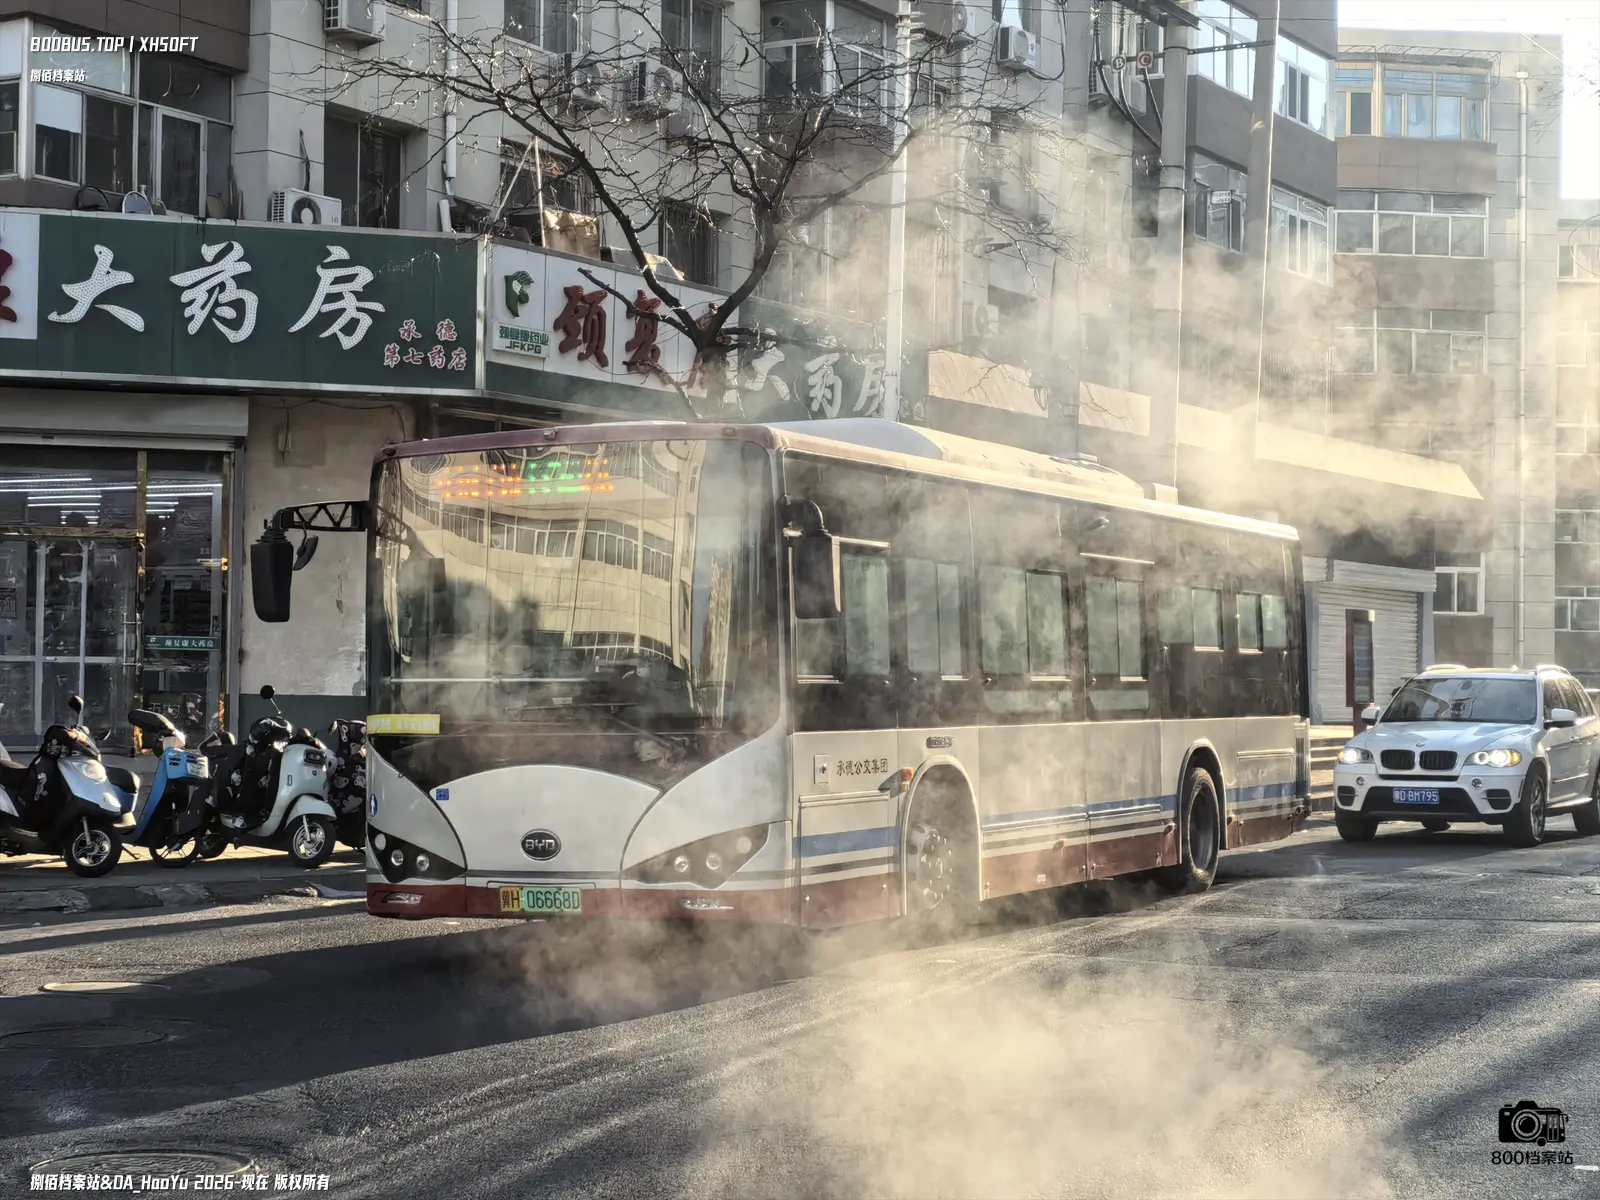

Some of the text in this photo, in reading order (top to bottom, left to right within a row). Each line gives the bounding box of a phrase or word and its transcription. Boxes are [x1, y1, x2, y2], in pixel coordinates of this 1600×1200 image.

[47, 240, 386, 350] 大药房
[399, 318, 458, 342] 承德
[383, 342, 467, 371] 第七药店
[505, 340, 541, 354] JFKPG
[836, 758, 889, 777] 承德公交集团
[525, 839, 555, 850] BYD
